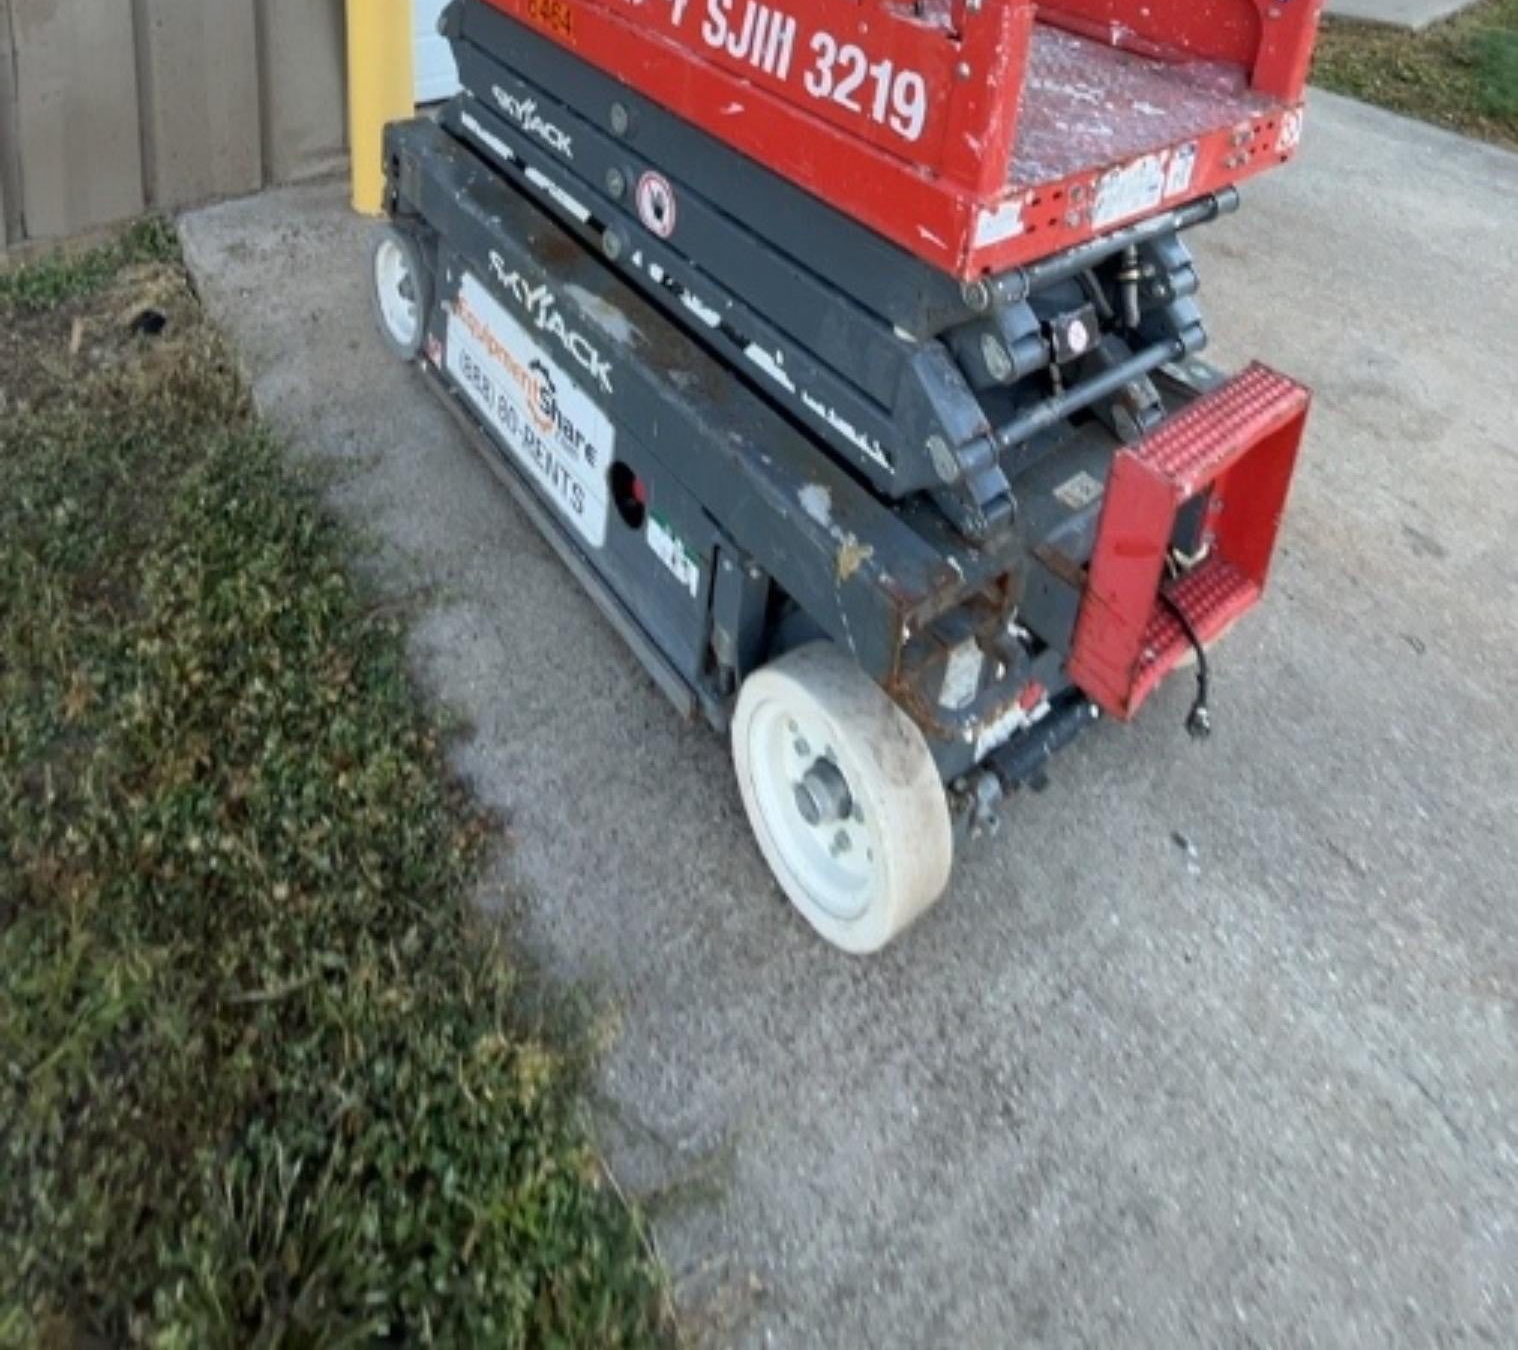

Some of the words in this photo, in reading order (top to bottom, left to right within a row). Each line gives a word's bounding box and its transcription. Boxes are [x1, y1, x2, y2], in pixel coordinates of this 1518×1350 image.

[491, 82, 573, 159] SKYJACK
[804, 32, 928, 141] 3219
[488, 250, 614, 394] SKYJACK
